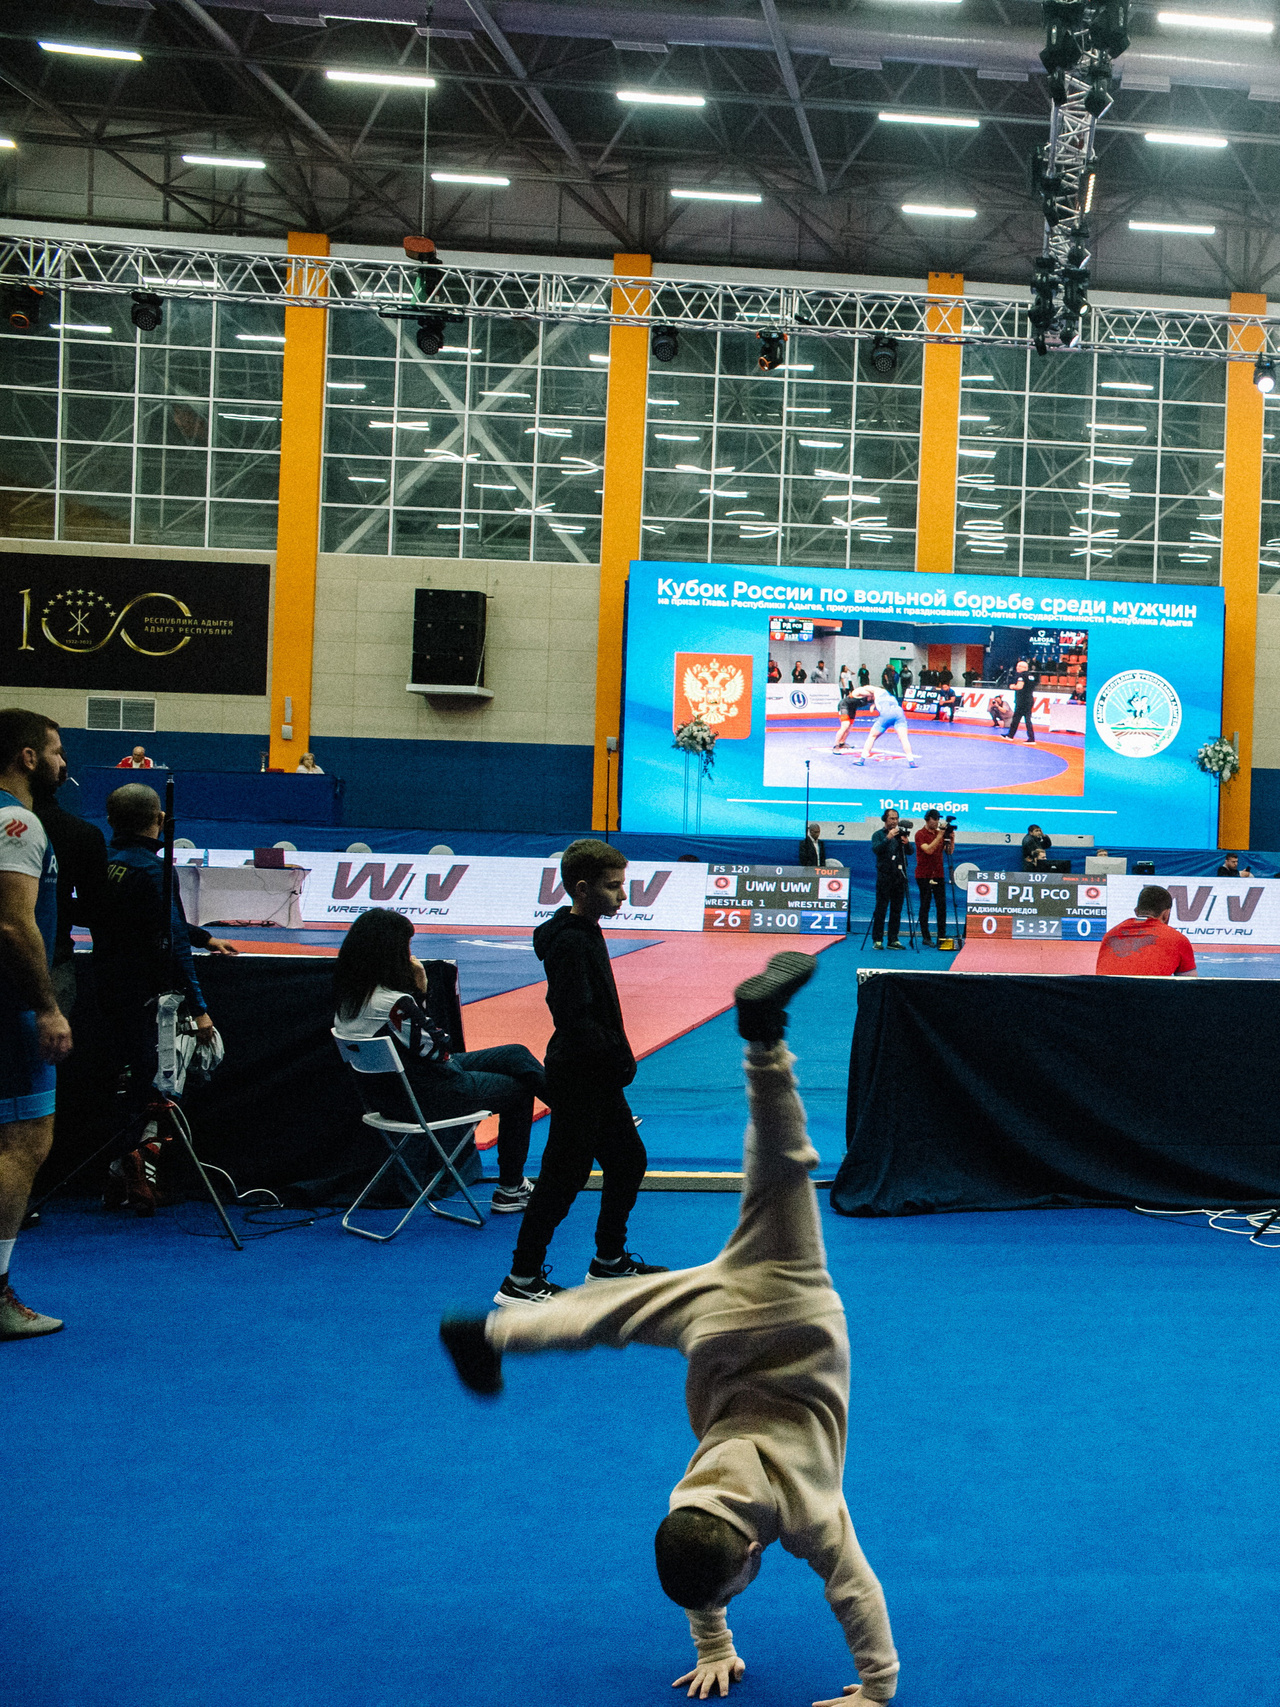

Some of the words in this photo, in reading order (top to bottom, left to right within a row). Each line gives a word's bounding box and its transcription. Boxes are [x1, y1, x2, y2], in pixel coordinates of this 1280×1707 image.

[657, 578, 727, 599] Кубок
[733, 580, 813, 600] России
[820, 588, 848, 602] по
[854, 588, 947, 607] вольной
[953, 591, 1035, 612] борьбе
[1040, 597, 1106, 616] среди
[1112, 601, 1197, 619] мужчин
[671, 598, 700, 607] призы
[702, 598, 729, 607] Главы
[731, 600, 786, 610] Республики
[787, 602, 824, 612] Адыгея,
[826, 603, 893, 614] приуроченный
[903, 607, 970, 618] празднованию
[971, 609, 1017, 619] 100-летия
[1018, 613, 1104, 623] государственности
[1105, 615, 1158, 626] Республика
[1159, 618, 1193, 627] Адыгея
[144, 616, 198, 626] РЕСПУБЛИКА
[201, 619, 234, 627] АДЫГЕЯ
[144, 625, 175, 634] АДЫГЭ
[178, 627, 233, 635] РЕСПУБЛИК
[879, 799, 909, 811] 10-11
[912, 801, 969, 814] декабря
[837, 824, 846, 836] 2
[1004, 833, 1012, 844] 3
[713, 865, 726, 873] FS
[731, 865, 750, 874] 120
[775, 866, 783, 875] 0
[815, 867, 839, 876] Tour
[976, 872, 988, 880] FS
[994, 872, 1006, 880] 86
[1029, 874, 1048, 882] 107
[745, 880, 777, 892] UWW
[780, 881, 812, 893] UWW
[1008, 885, 1034, 903] РД
[1040, 889, 1070, 900] РСО
[705, 899, 754, 907] WRESTLER
[759, 899, 766, 907] 1
[788, 901, 837, 909] WRESTLER
[841, 901, 848, 909] 2
[966, 906, 1038, 915] ГАДЖИМАГОМЕДОВ
[1066, 908, 1107, 916] ТАПСИЕВ
[713, 910, 741, 928] 26
[753, 912, 799, 928] 3:00
[810, 912, 838, 930] 21
[982, 916, 997, 935] 0
[1016, 920, 1060, 934] 5:37
[1076, 918, 1092, 937] 0
